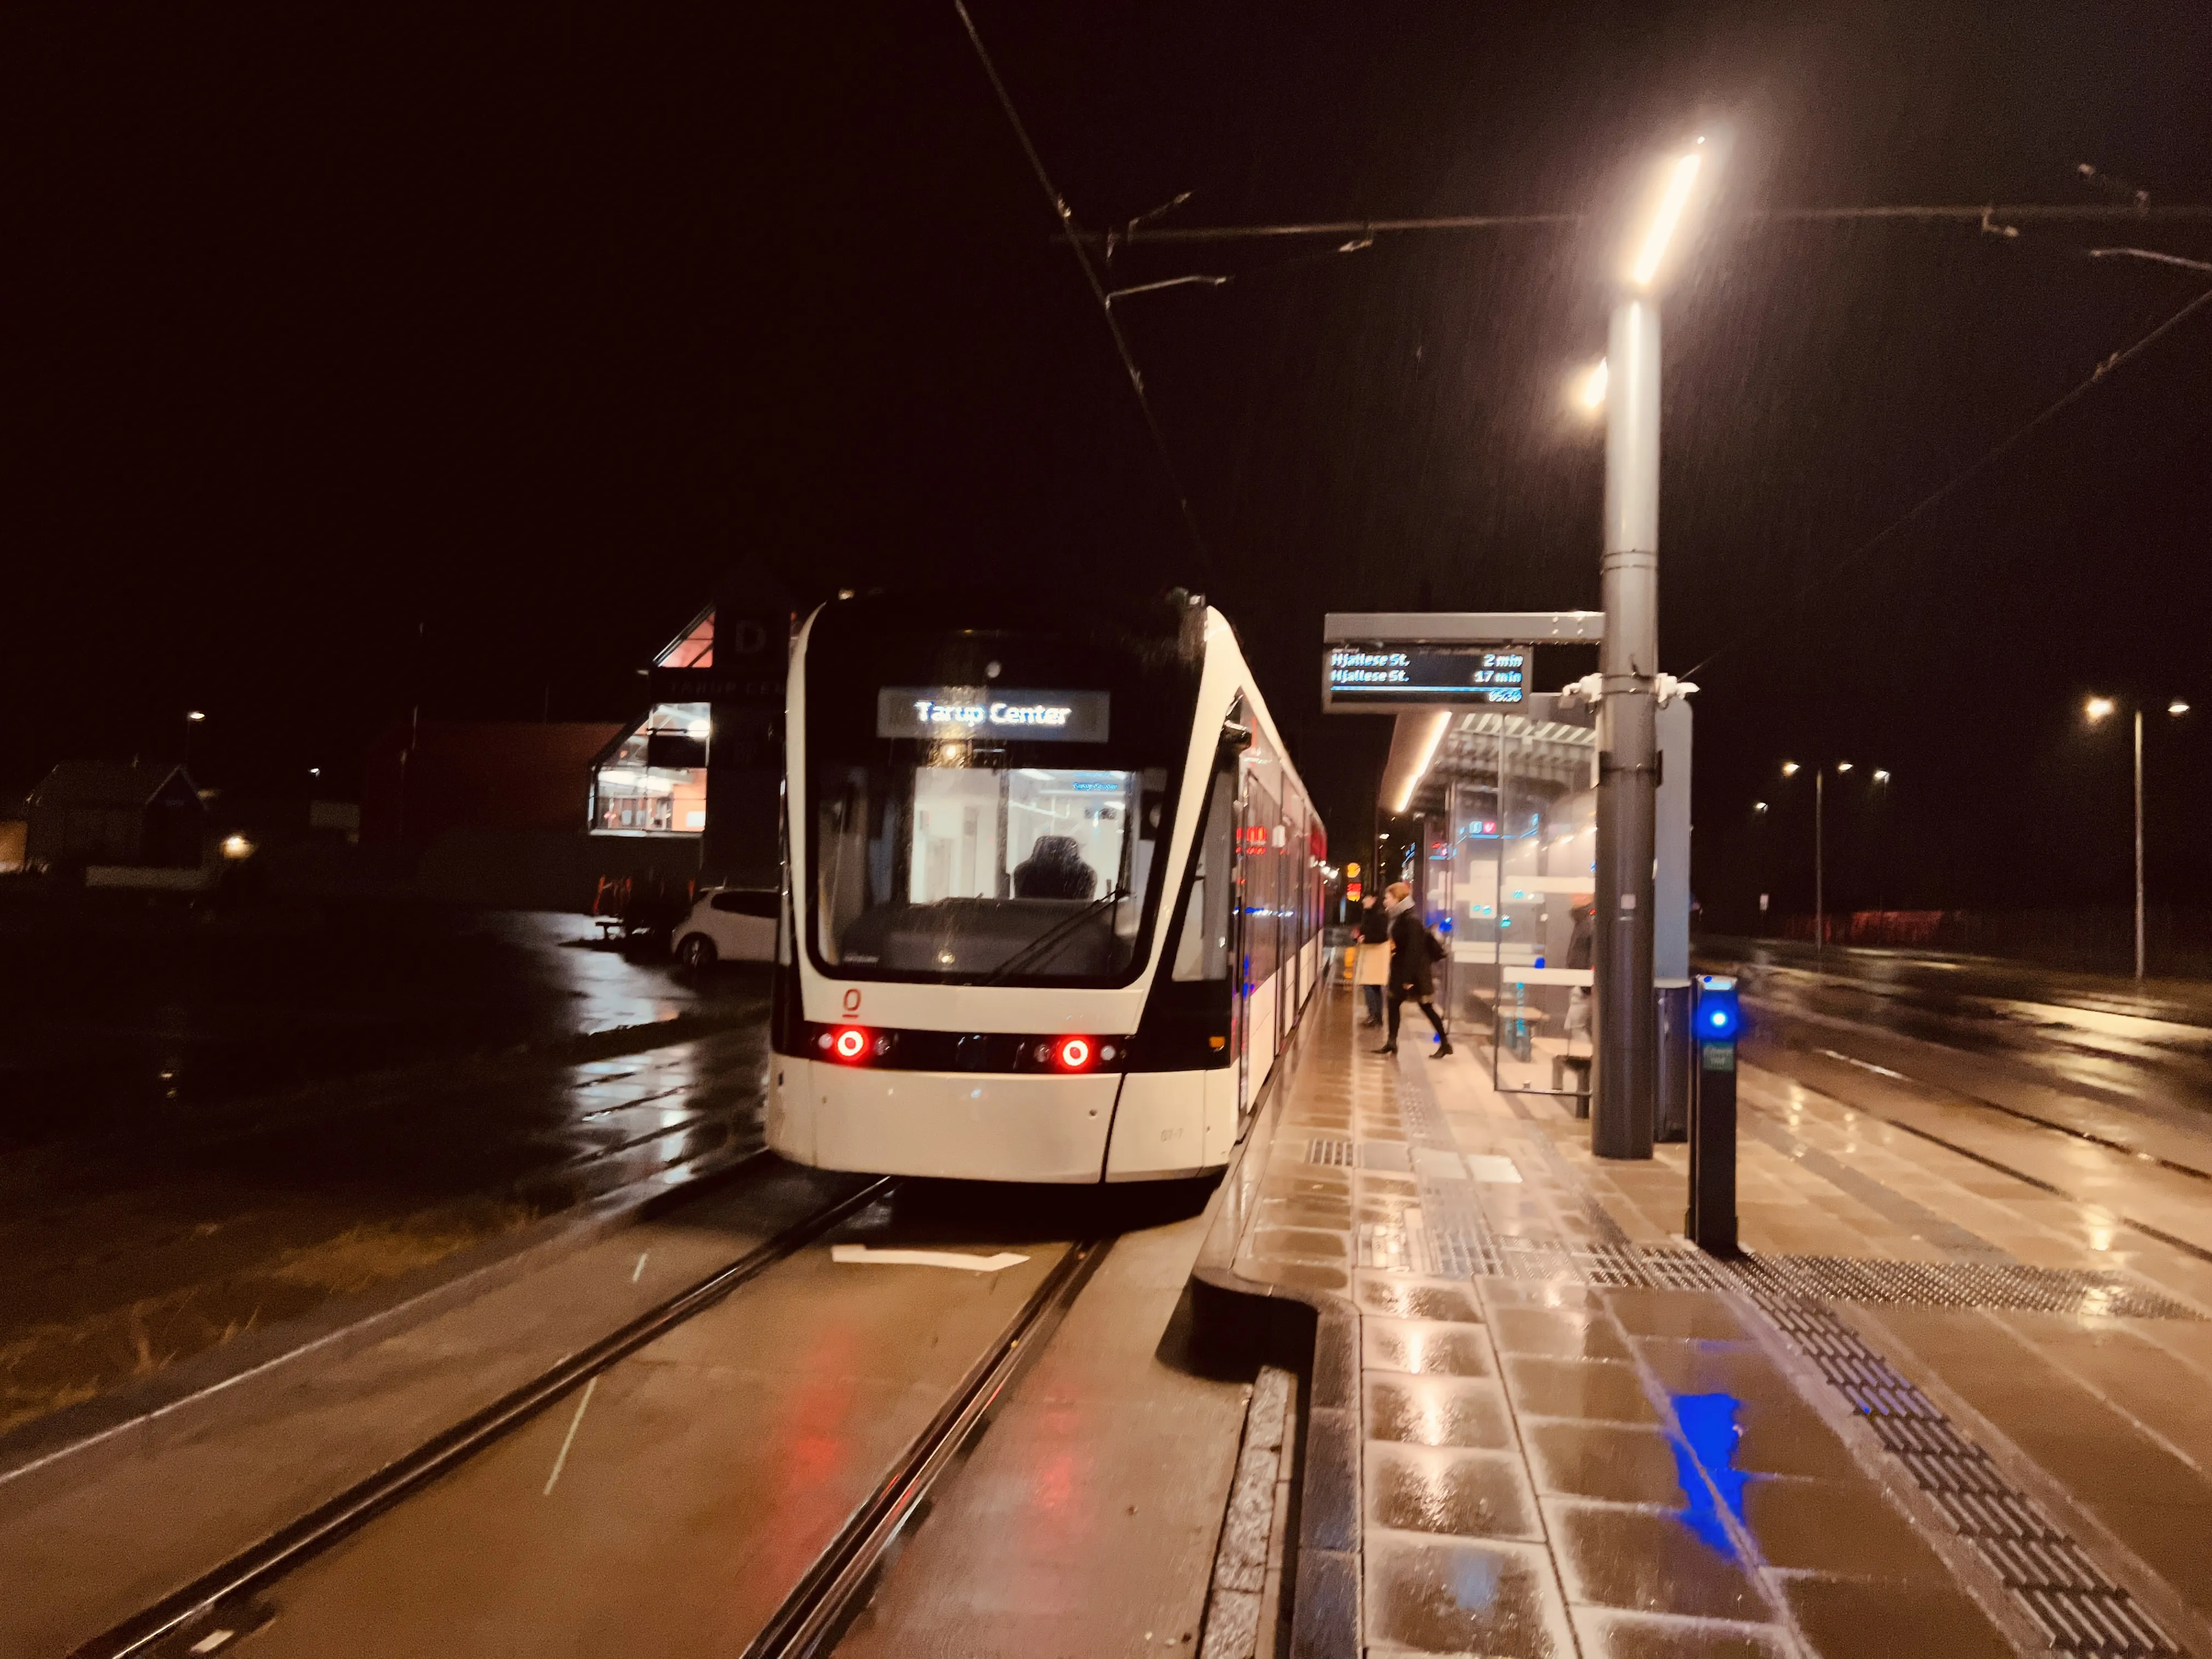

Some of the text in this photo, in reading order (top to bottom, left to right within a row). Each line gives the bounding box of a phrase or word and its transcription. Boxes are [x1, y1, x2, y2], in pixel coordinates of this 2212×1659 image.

[1331, 653, 1389, 668] Hjallese
[1483, 654, 1523, 667] 2 min
[1330, 669, 1387, 683] Hjallese
[1475, 670, 1522, 682] 17 min
[915, 701, 1072, 727] Tarup Center
